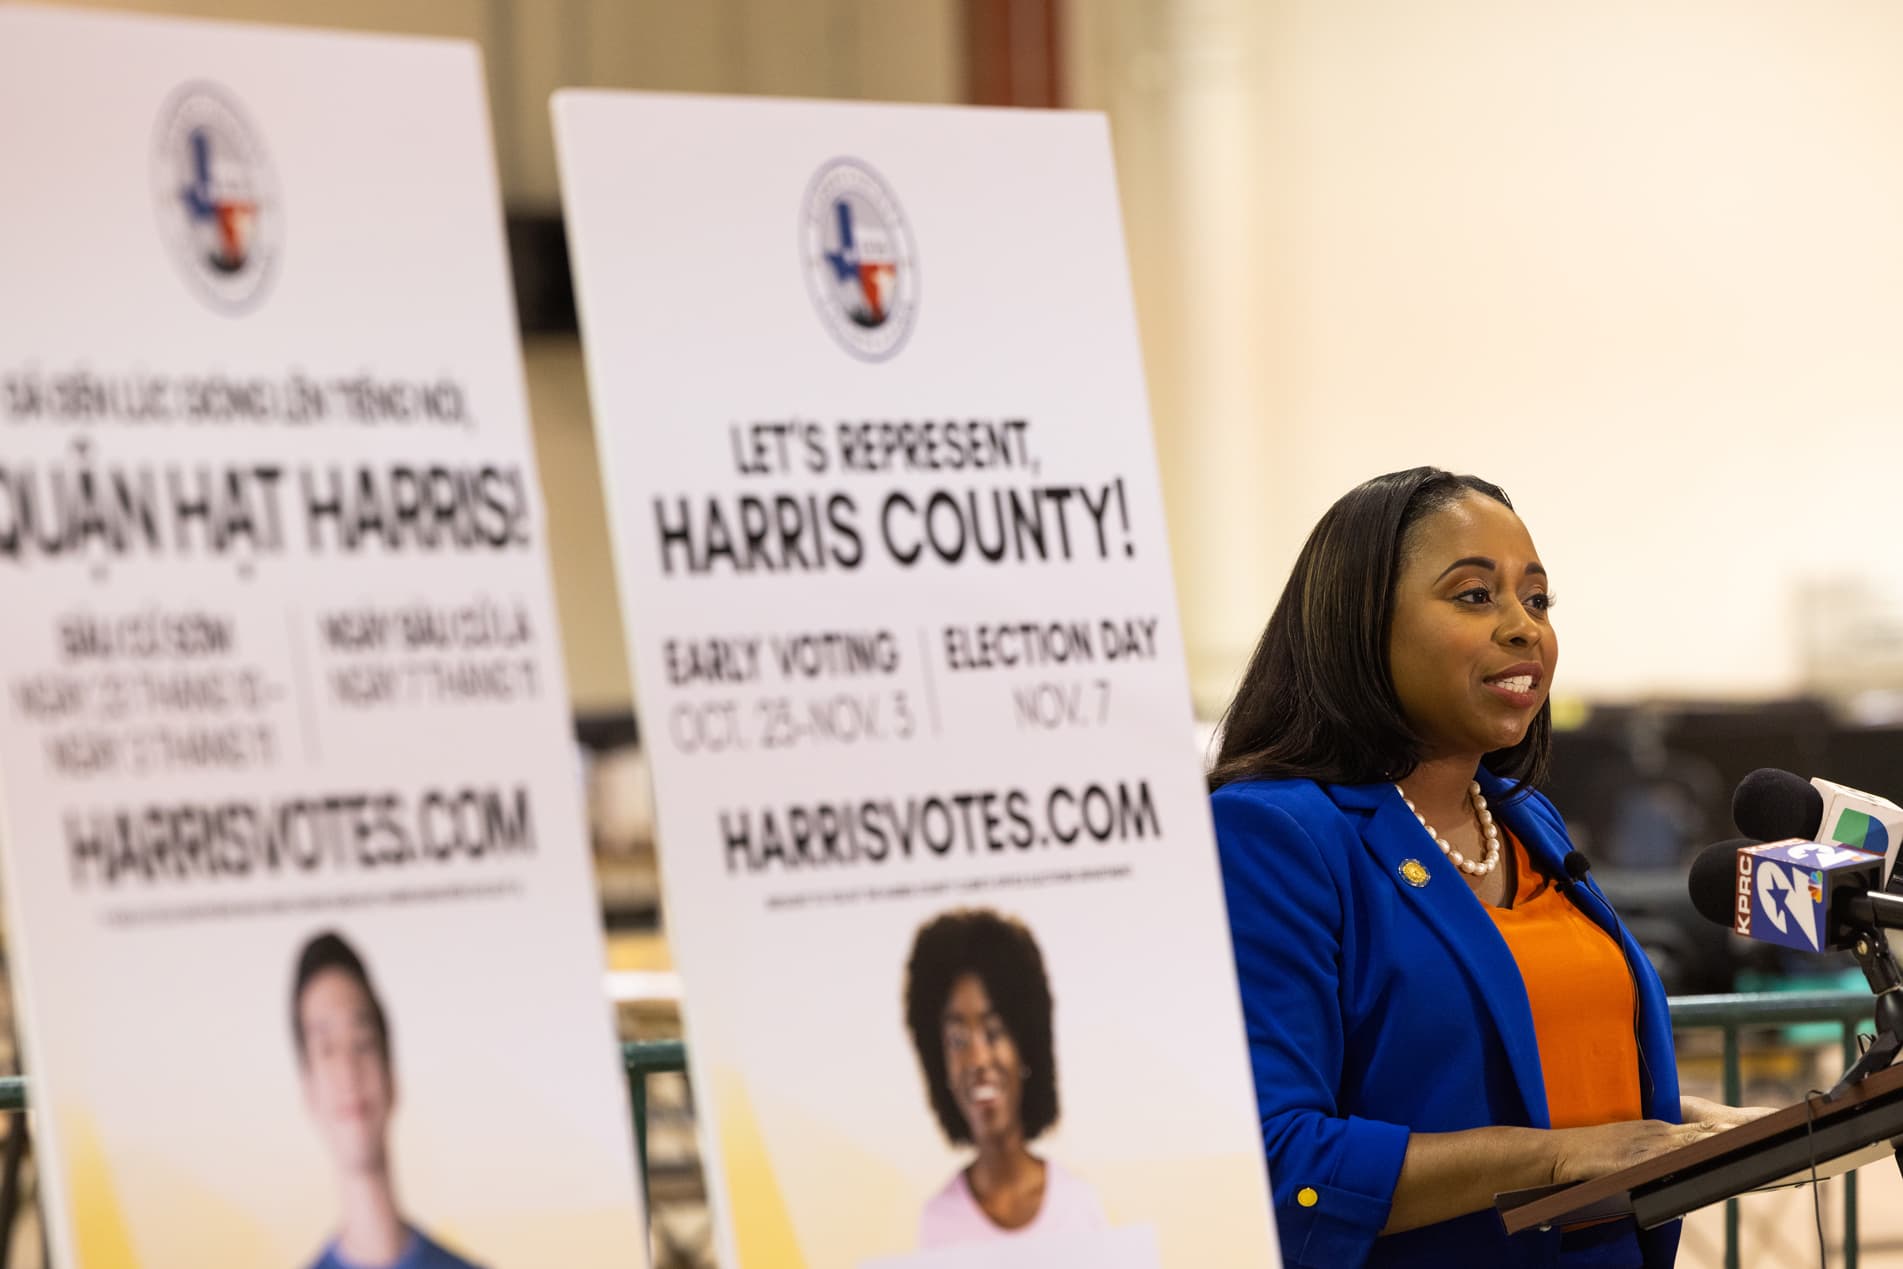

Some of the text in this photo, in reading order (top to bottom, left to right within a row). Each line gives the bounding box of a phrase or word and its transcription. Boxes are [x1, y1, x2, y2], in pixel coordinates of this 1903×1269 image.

[731, 420, 1040, 476] LET'S REPRESENT,
[655, 478, 1135, 576] HARRIS COUNTY!
[664, 629, 899, 687] EARLY VOTING
[943, 616, 1160, 670] ELECTION DAY
[1013, 680, 1112, 731] NOV. 7
[720, 779, 1163, 875] HARRISVOTES.COM
[1737, 855, 1752, 935] KPRC
